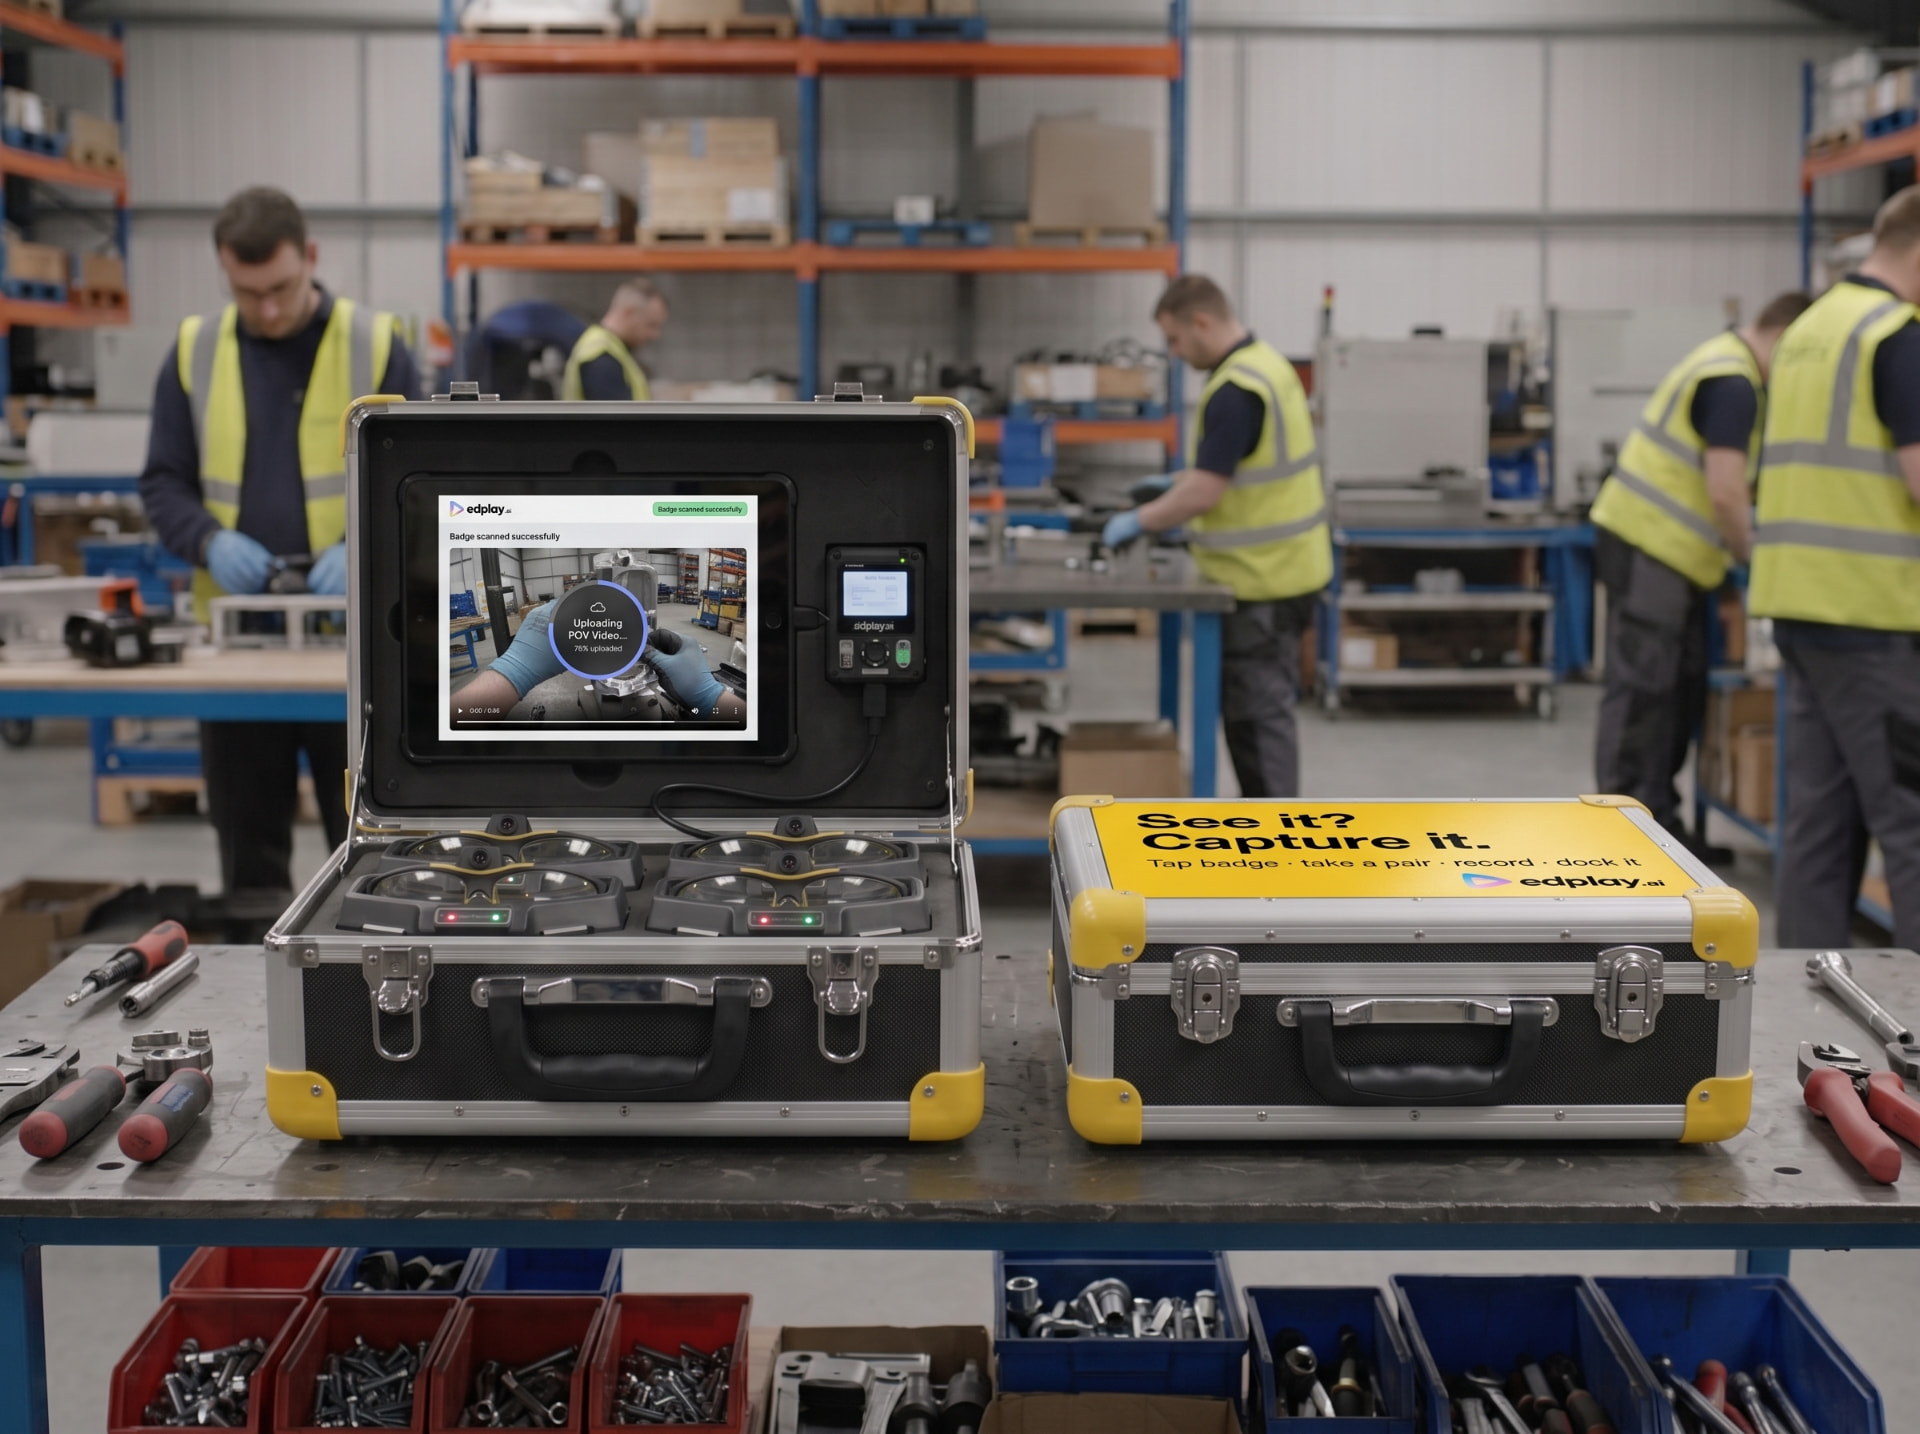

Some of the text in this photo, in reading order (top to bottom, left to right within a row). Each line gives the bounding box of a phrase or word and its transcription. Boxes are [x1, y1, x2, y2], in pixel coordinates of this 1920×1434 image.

[657, 504, 743, 514] Badge scanned successfully
[449, 532, 560, 541] Badge scanned successfully
[573, 618, 623, 630] Uploading
[568, 630, 590, 640] POV
[590, 644, 623, 654] uploaded
[1137, 813, 1356, 829] See it?
[1142, 832, 1491, 855] Capture it.
[1147, 859, 1192, 870] Tap
[1200, 859, 1279, 870] badge
[1300, 859, 1355, 868] take
[1384, 859, 1432, 870] pair
[1453, 858, 1535, 868] record
[1556, 858, 1617, 867] dock
[1622, 858, 1643, 867] it
[1519, 876, 1667, 889] edplay.ai
